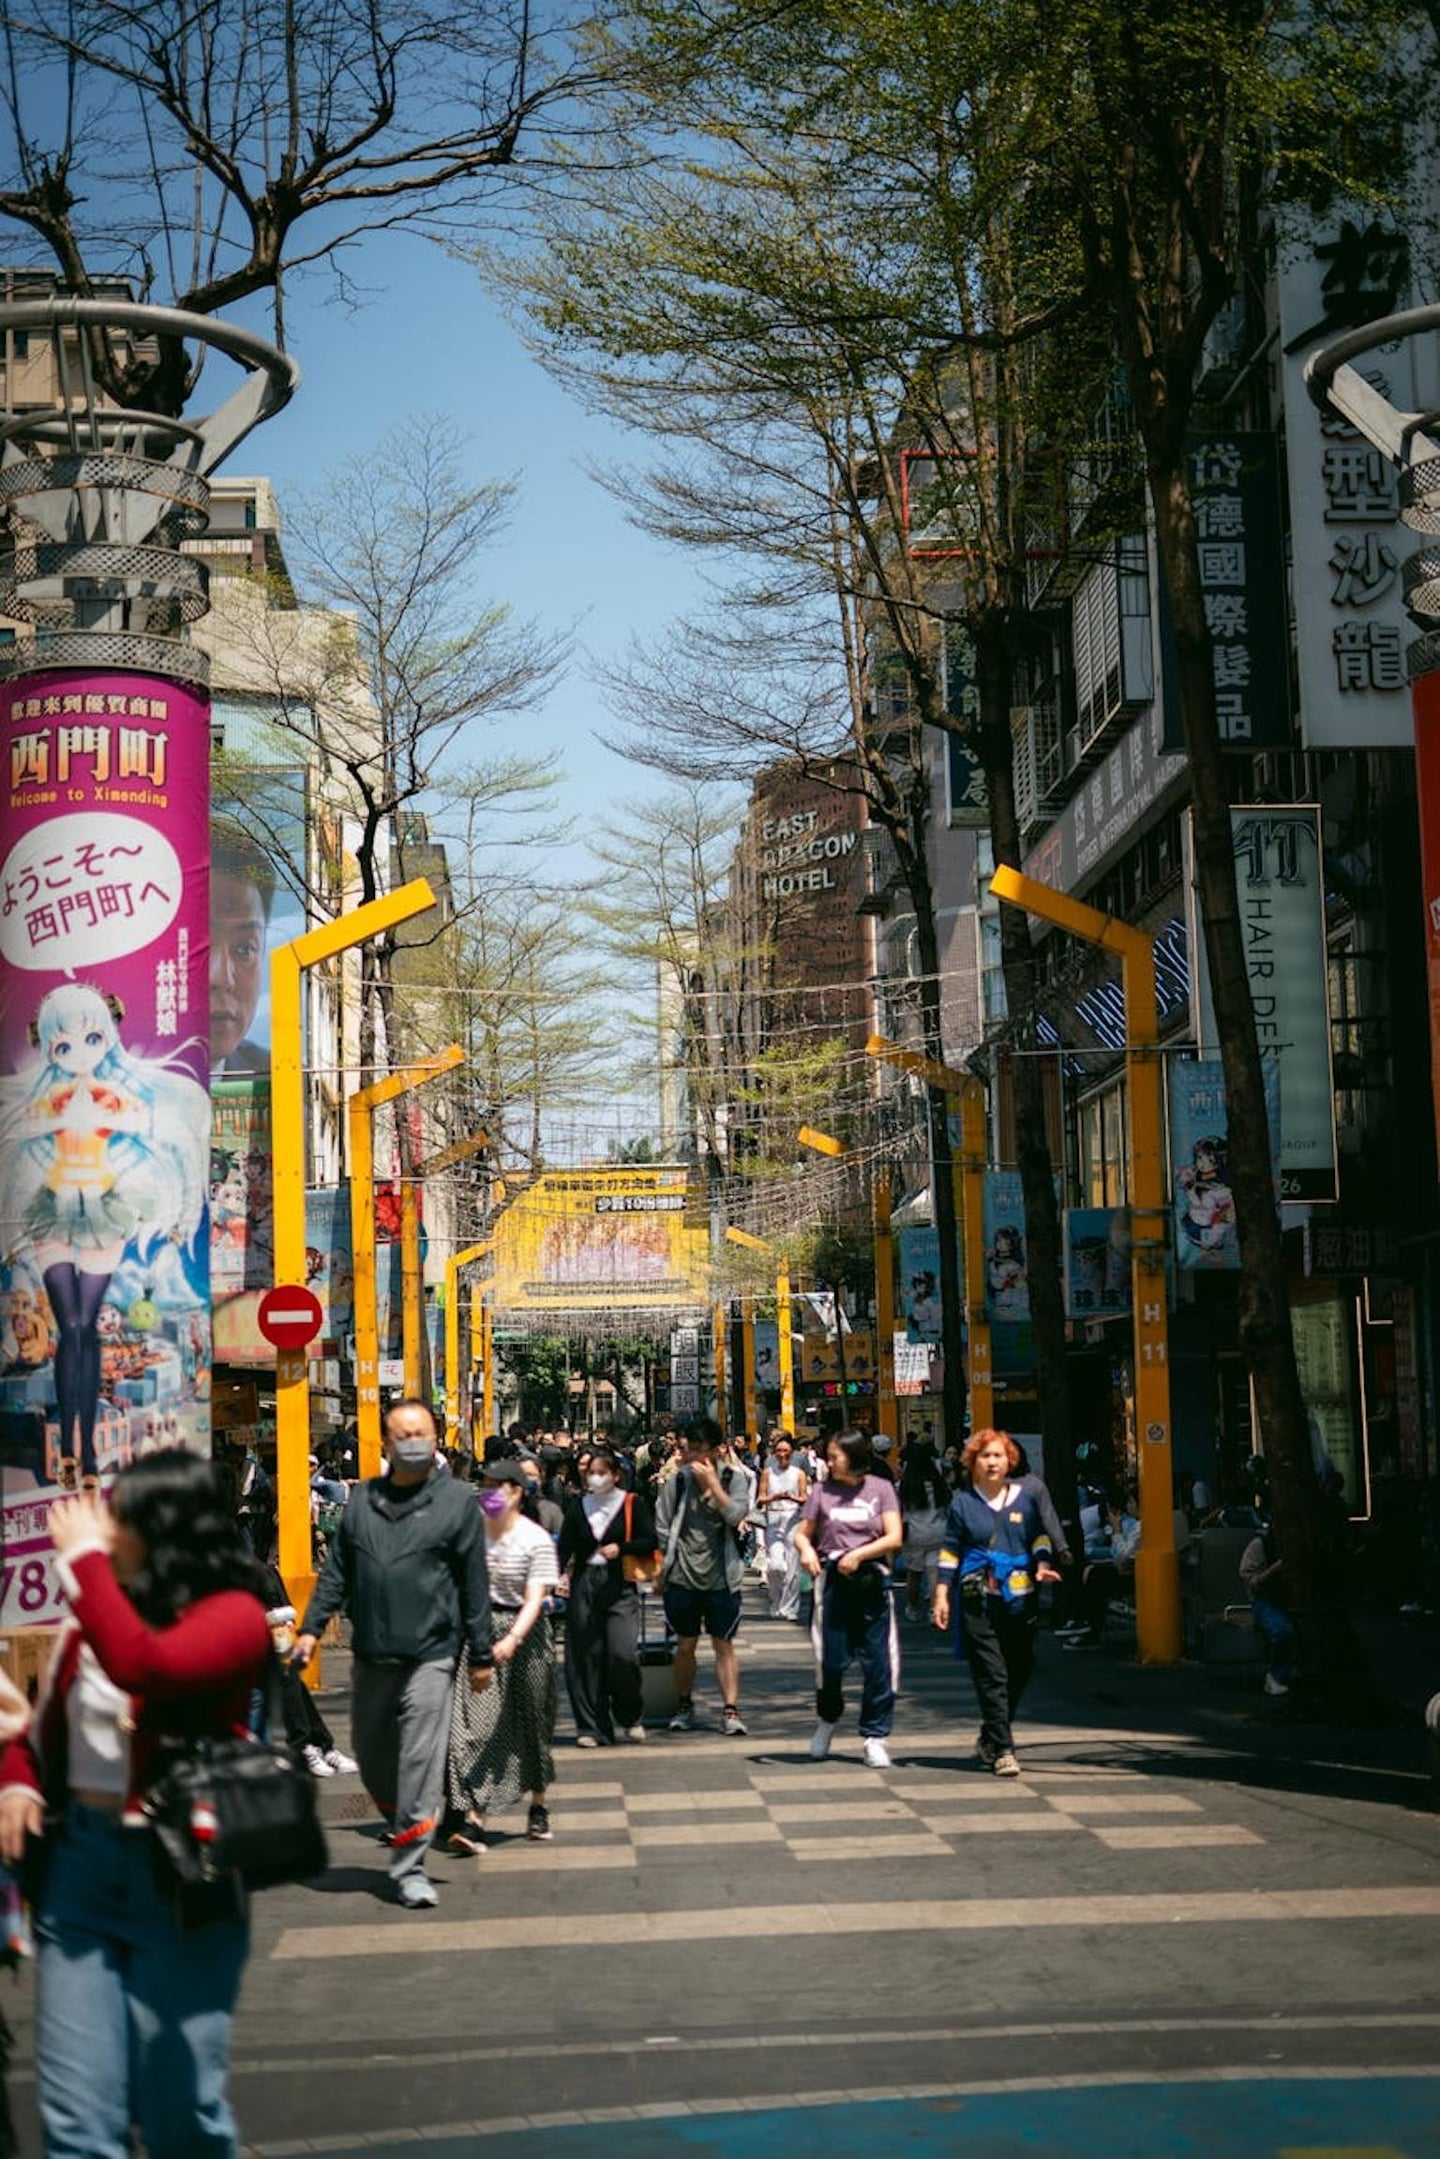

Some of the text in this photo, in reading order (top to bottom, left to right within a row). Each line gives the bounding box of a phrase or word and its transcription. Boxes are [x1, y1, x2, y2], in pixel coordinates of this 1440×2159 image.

[1194, 443, 1252, 741] 岱德國際髮品
[10, 725, 169, 790] 西門町
[68, 788, 84, 802] to
[94, 787, 169, 809] Ximending
[763, 810, 819, 841] EAST
[764, 867, 836, 900] HOTEL
[24, 880, 172, 948] 西門町へ
[1246, 899, 1275, 978] HAIR
[1143, 1304, 1160, 1322] H
[975, 1344, 986, 1356] H
[1142, 1343, 1166, 1362] 11
[280, 1362, 305, 1381] 12
[360, 1360, 373, 1374] H
[359, 1389, 377, 1402] 10
[1, 1559, 66, 1611] 78
